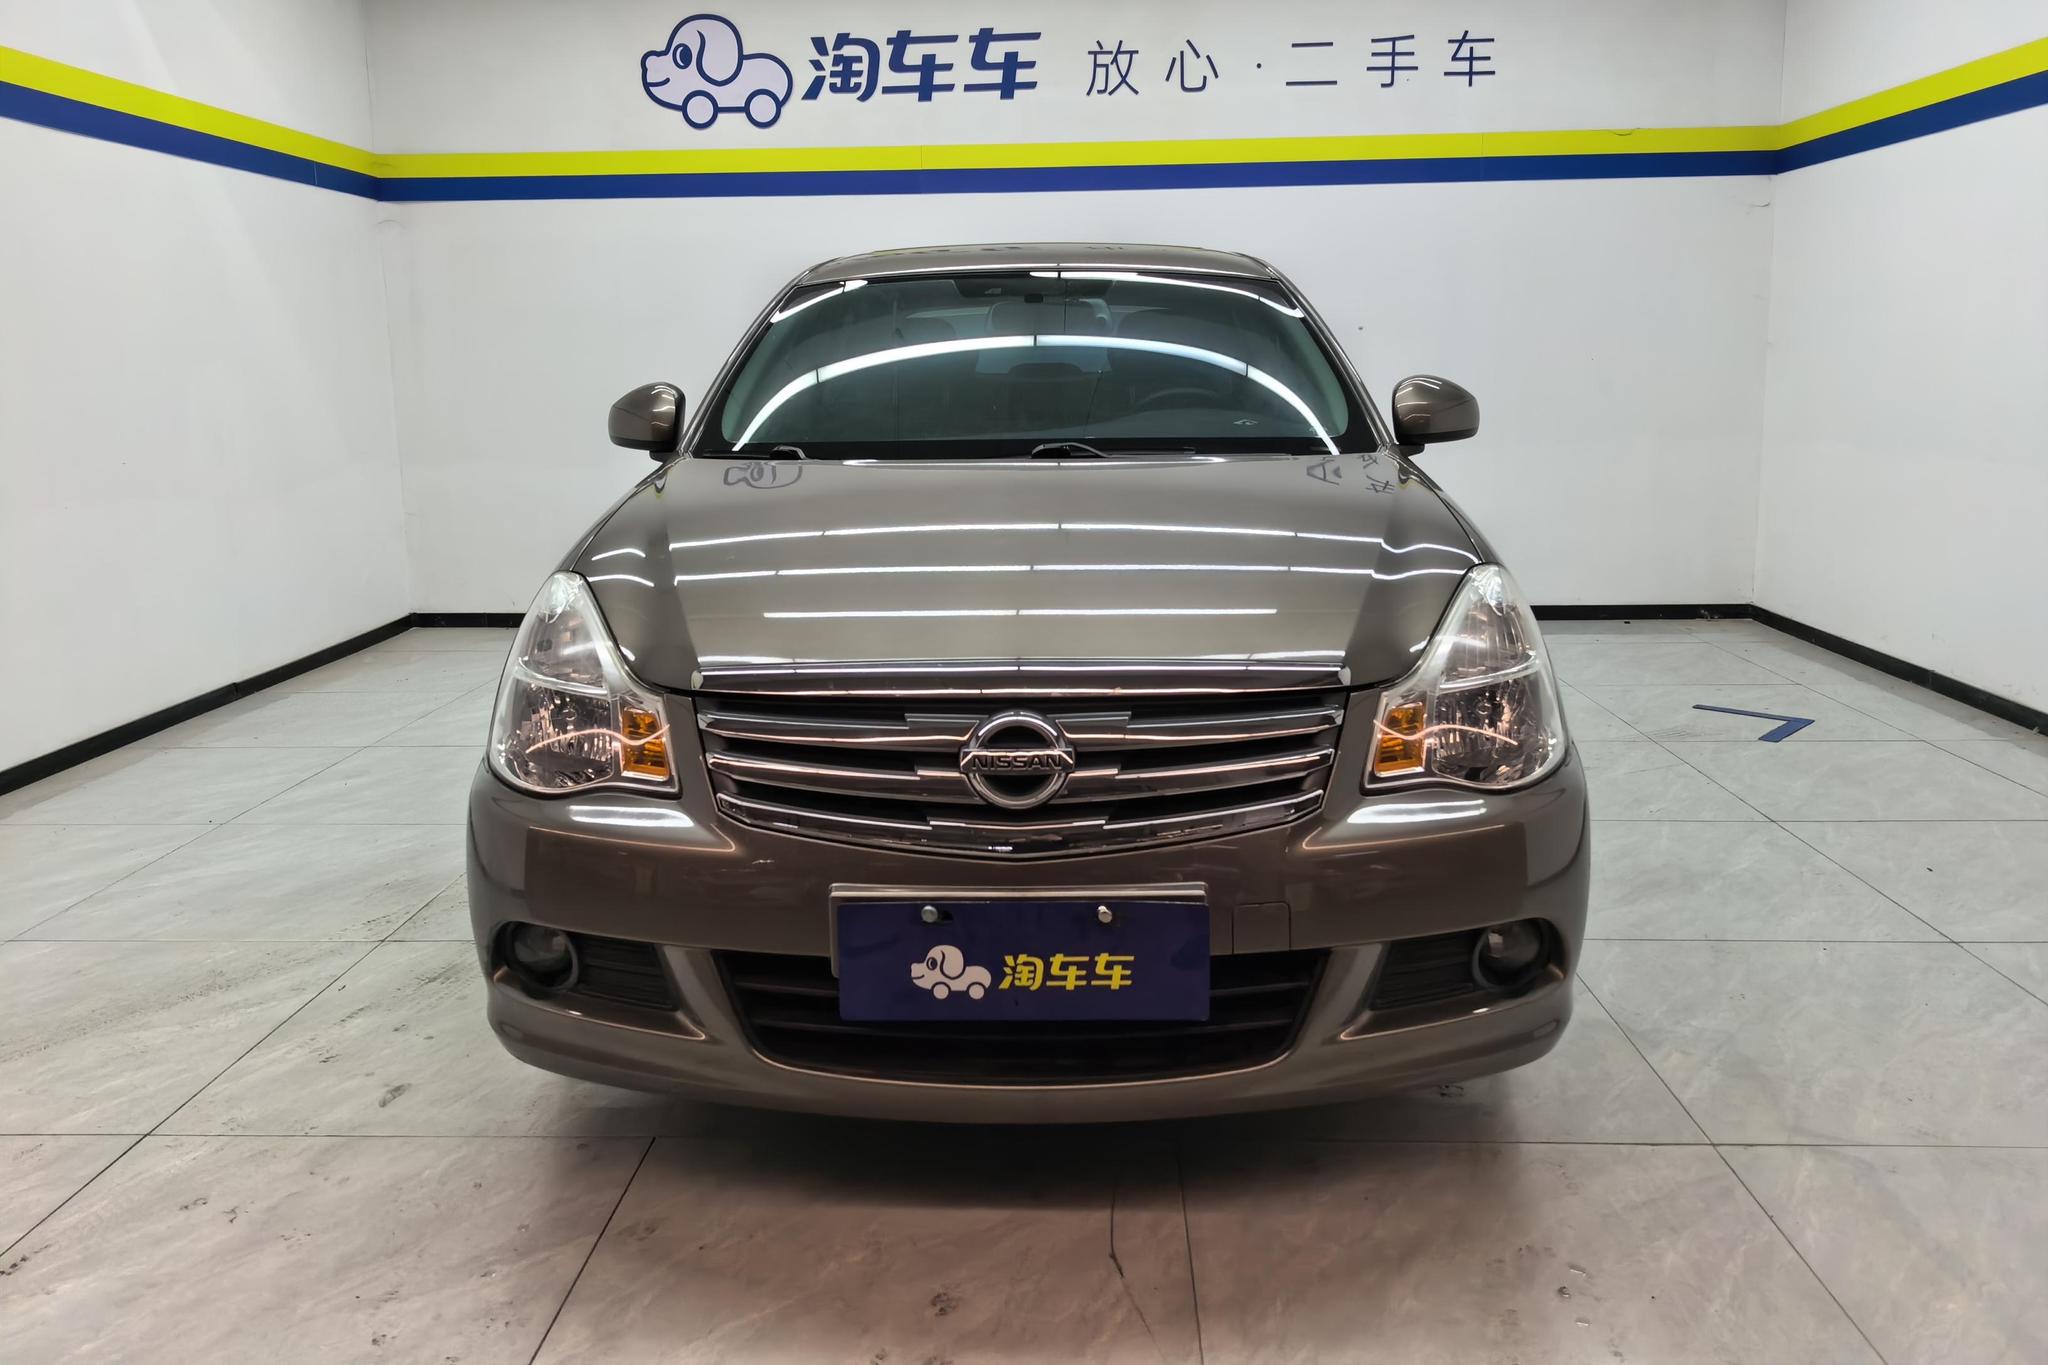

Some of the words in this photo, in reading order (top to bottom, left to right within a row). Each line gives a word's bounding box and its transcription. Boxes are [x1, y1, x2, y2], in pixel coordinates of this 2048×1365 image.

[801, 28, 1042, 103] 淘车车
[971, 754, 1062, 770] NISSAN
[998, 952, 1135, 991] 淘车车
